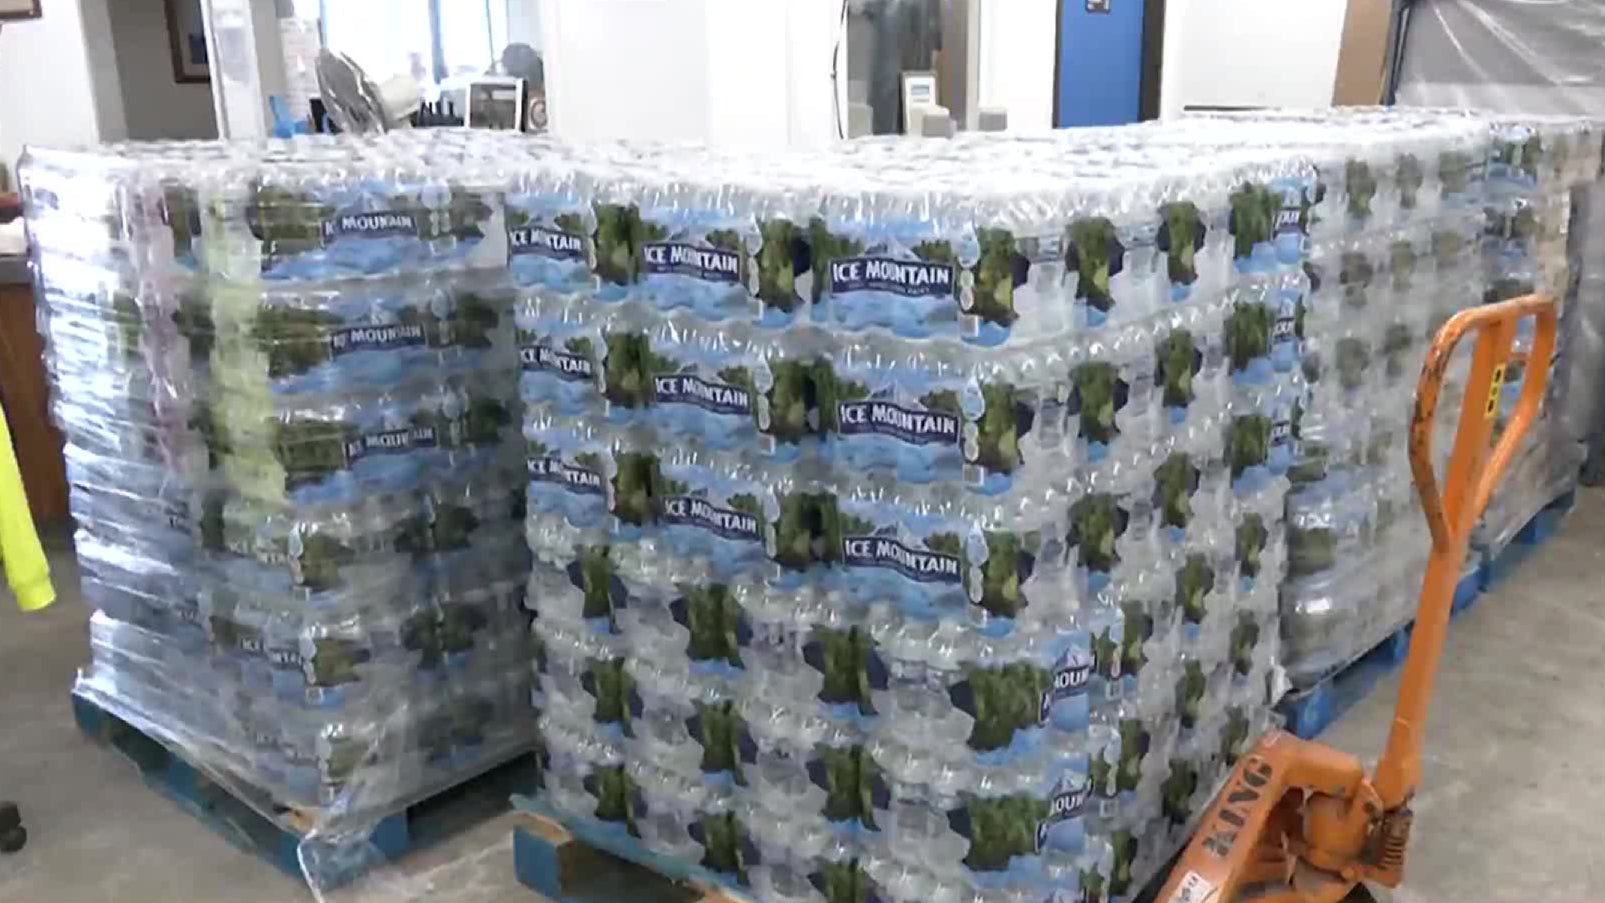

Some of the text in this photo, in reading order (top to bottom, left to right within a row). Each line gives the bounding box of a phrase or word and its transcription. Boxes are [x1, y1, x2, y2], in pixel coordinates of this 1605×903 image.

[341, 215, 413, 231] MOUNAIN
[531, 227, 582, 251] MNTAIN
[643, 245, 667, 265] ICE
[832, 259, 949, 287] ICE MOUNTAIN
[350, 326, 421, 343] MOUNAIN
[539, 346, 592, 376] MNTAIN
[655, 378, 679, 396] ICE
[840, 403, 956, 435] ICE MOUNTAIN
[548, 458, 601, 490] MNTAIN
[664, 499, 687, 518] ICE
[845, 539, 958, 574] ICE MOUNTAIN
[1202, 755, 1273, 858] KING
